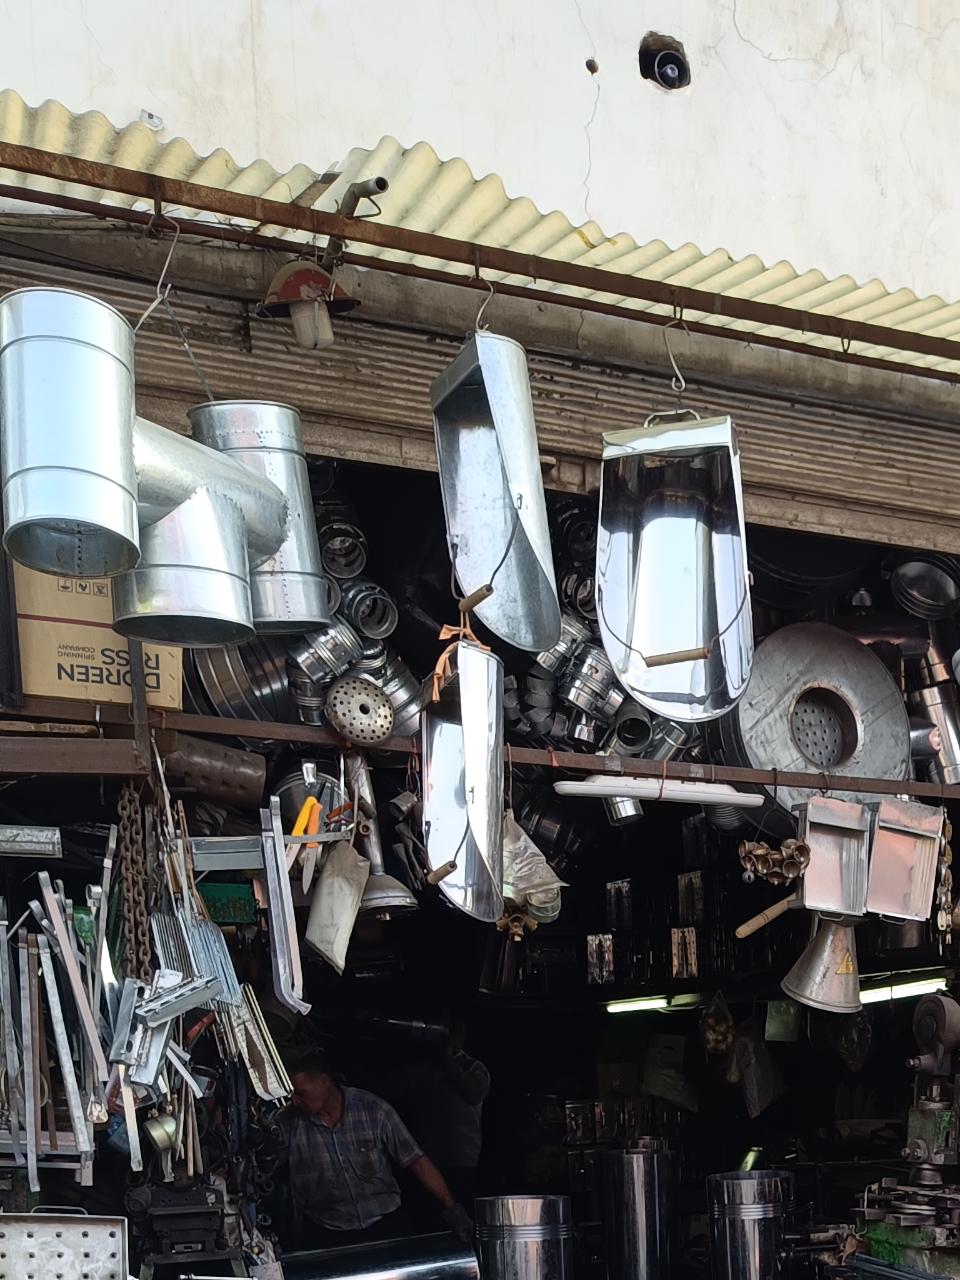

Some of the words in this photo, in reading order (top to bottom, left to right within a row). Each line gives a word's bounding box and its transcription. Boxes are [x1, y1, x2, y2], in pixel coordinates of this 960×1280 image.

[57, 644, 96, 653] COMPANY
[57, 651, 96, 661] SPINNING
[100, 647, 160, 671] RSS
[57, 662, 161, 690] DOREEN
